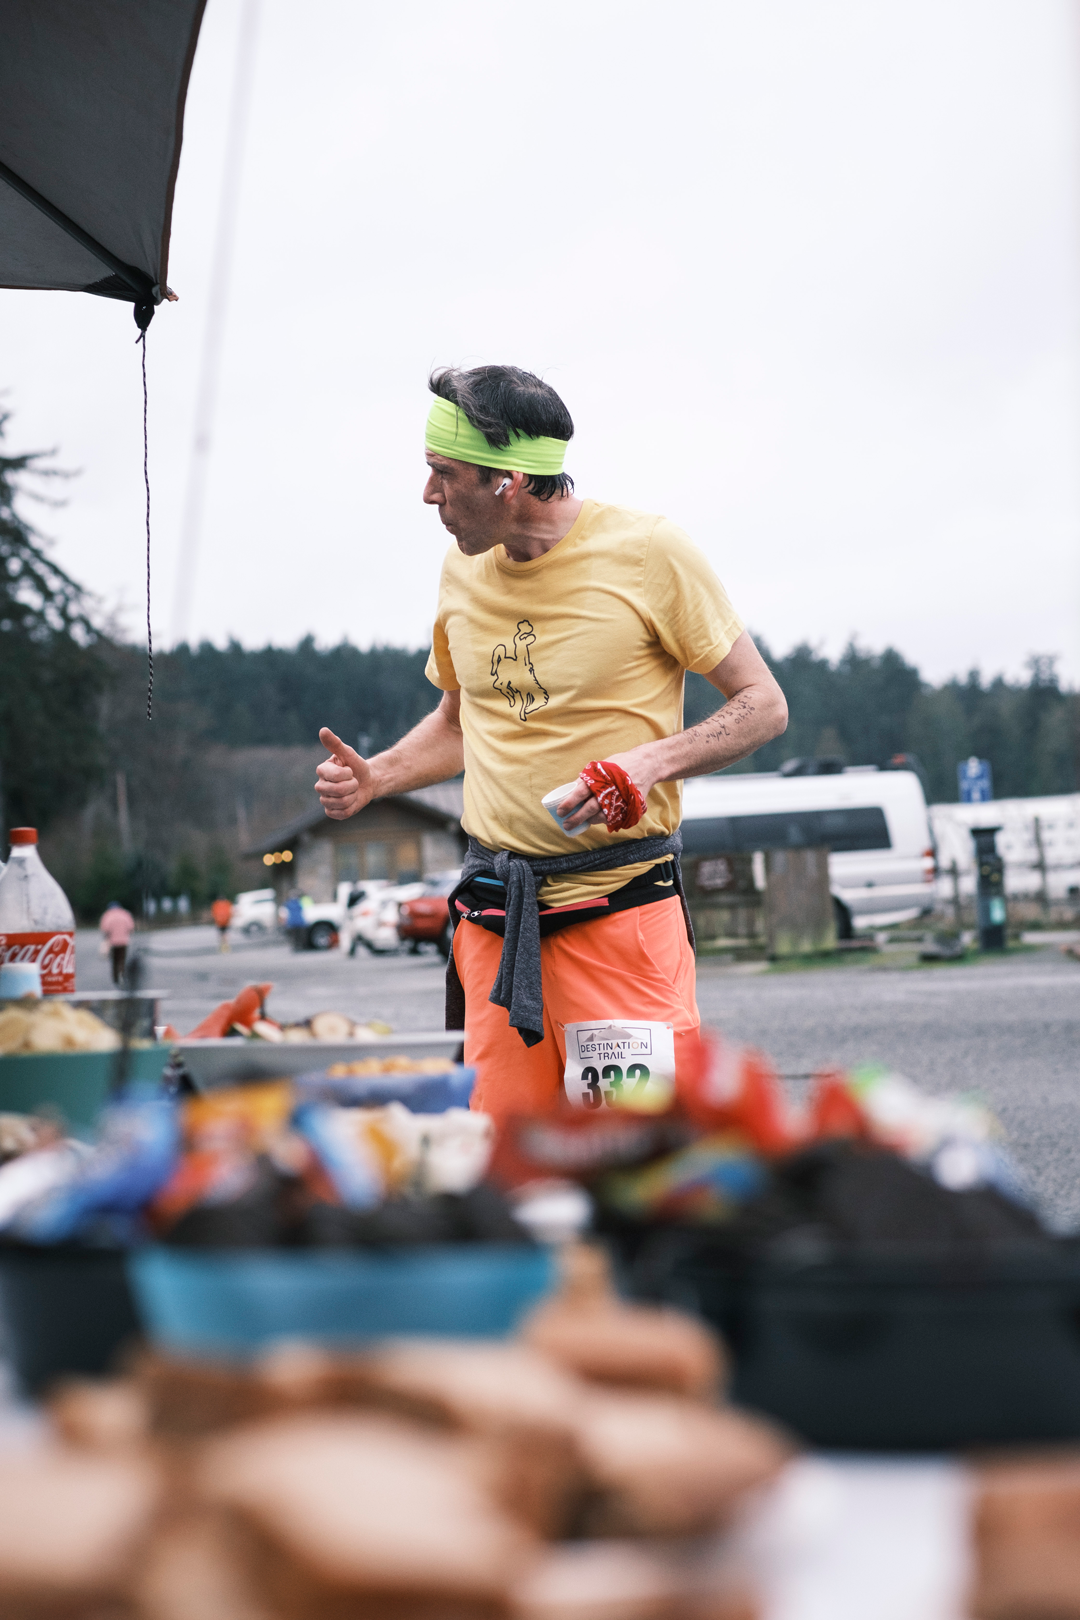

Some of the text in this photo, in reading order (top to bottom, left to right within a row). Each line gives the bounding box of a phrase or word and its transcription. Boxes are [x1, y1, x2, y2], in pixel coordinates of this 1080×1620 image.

[580, 1041, 648, 1053] DESTINATION
[597, 1051, 626, 1061] TRAIL
[581, 1063, 651, 1110] 332
